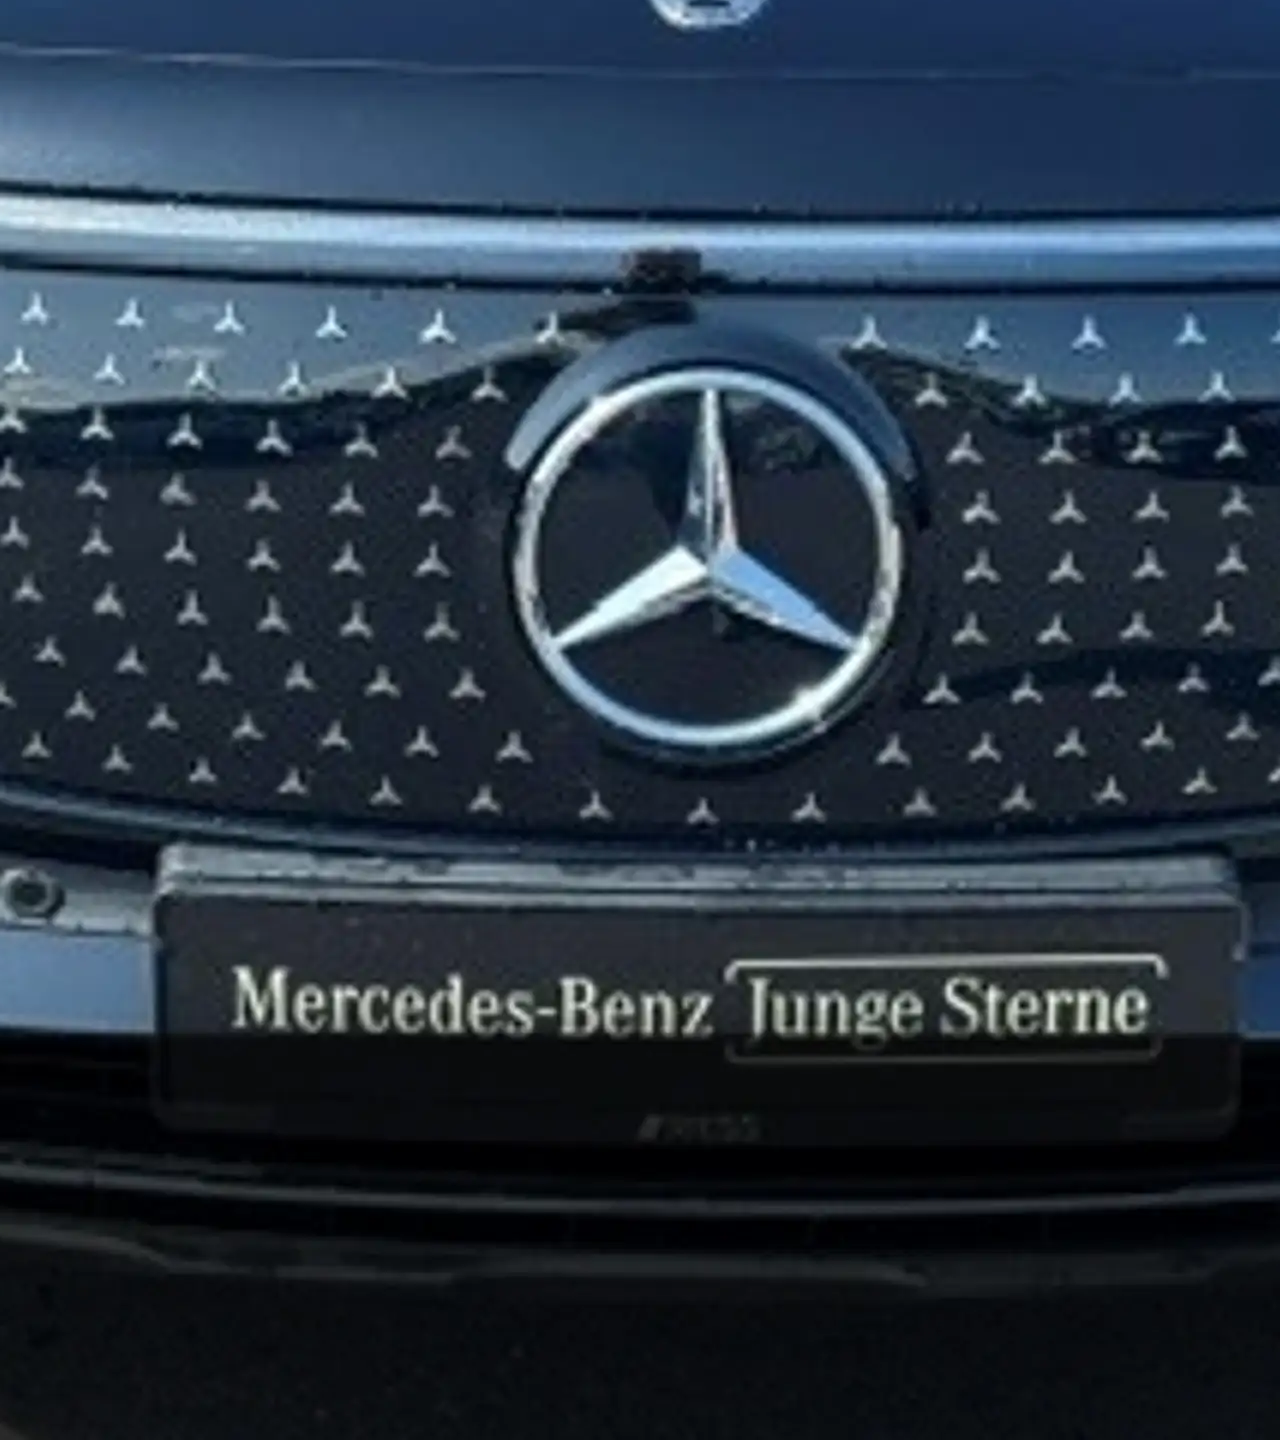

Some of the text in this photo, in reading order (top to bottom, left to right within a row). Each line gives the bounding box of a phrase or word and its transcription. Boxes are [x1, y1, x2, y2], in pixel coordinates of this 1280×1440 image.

[230, 963, 1150, 1050] Mercedes-Benz Junge Sterne
